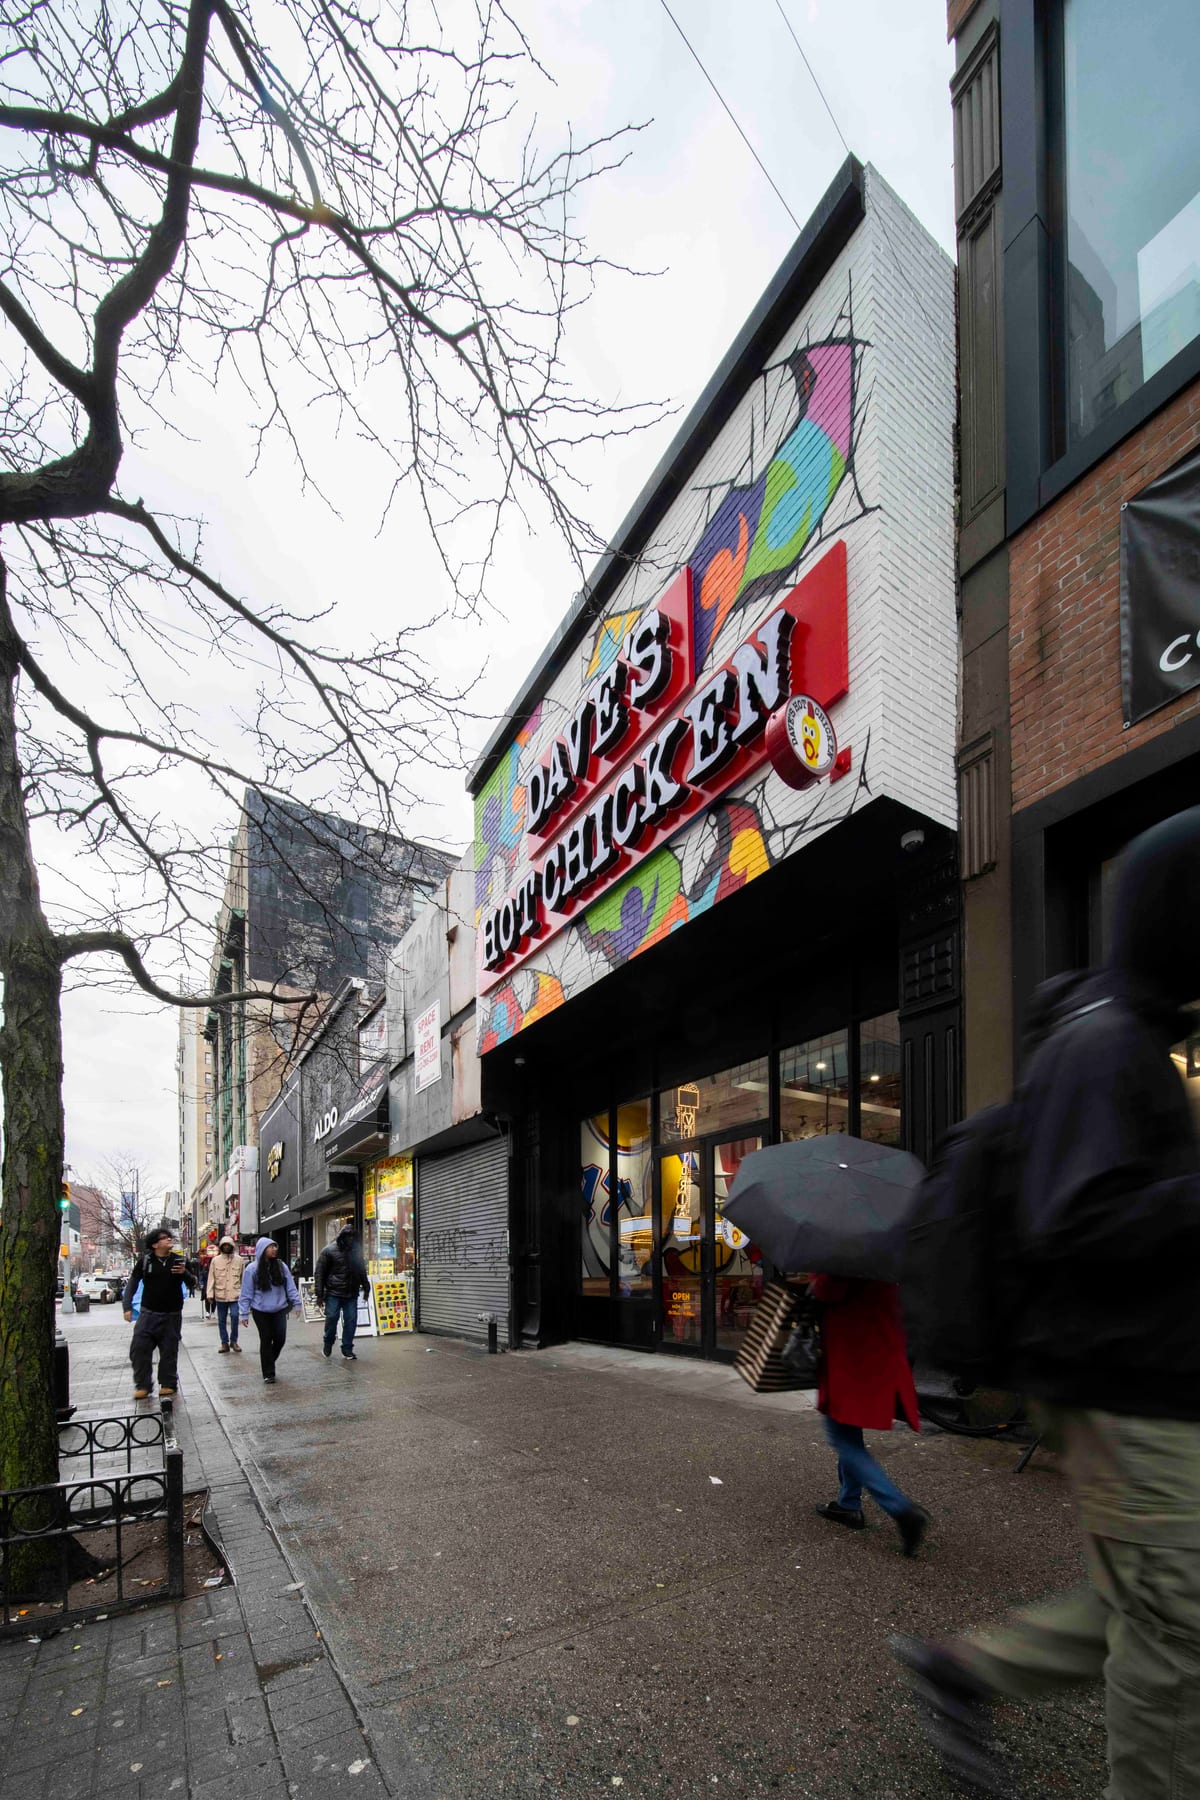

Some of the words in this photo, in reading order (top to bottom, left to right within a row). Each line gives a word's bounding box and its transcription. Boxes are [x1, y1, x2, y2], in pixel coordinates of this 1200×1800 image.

[1159, 629, 1200, 672] C
[524, 608, 671, 836] DAVE'S
[792, 699, 807, 712] HOT
[787, 707, 798, 746] DAVE'S
[814, 706, 834, 760] CHICKEN
[481, 870, 543, 972] HOT
[542, 608, 798, 913] CHICKEN
[418, 1009, 436, 1033] SPACE
[420, 1036, 434, 1055] RENT
[313, 1106, 338, 1144] ALDO
[672, 1292, 690, 1301] OPEN
